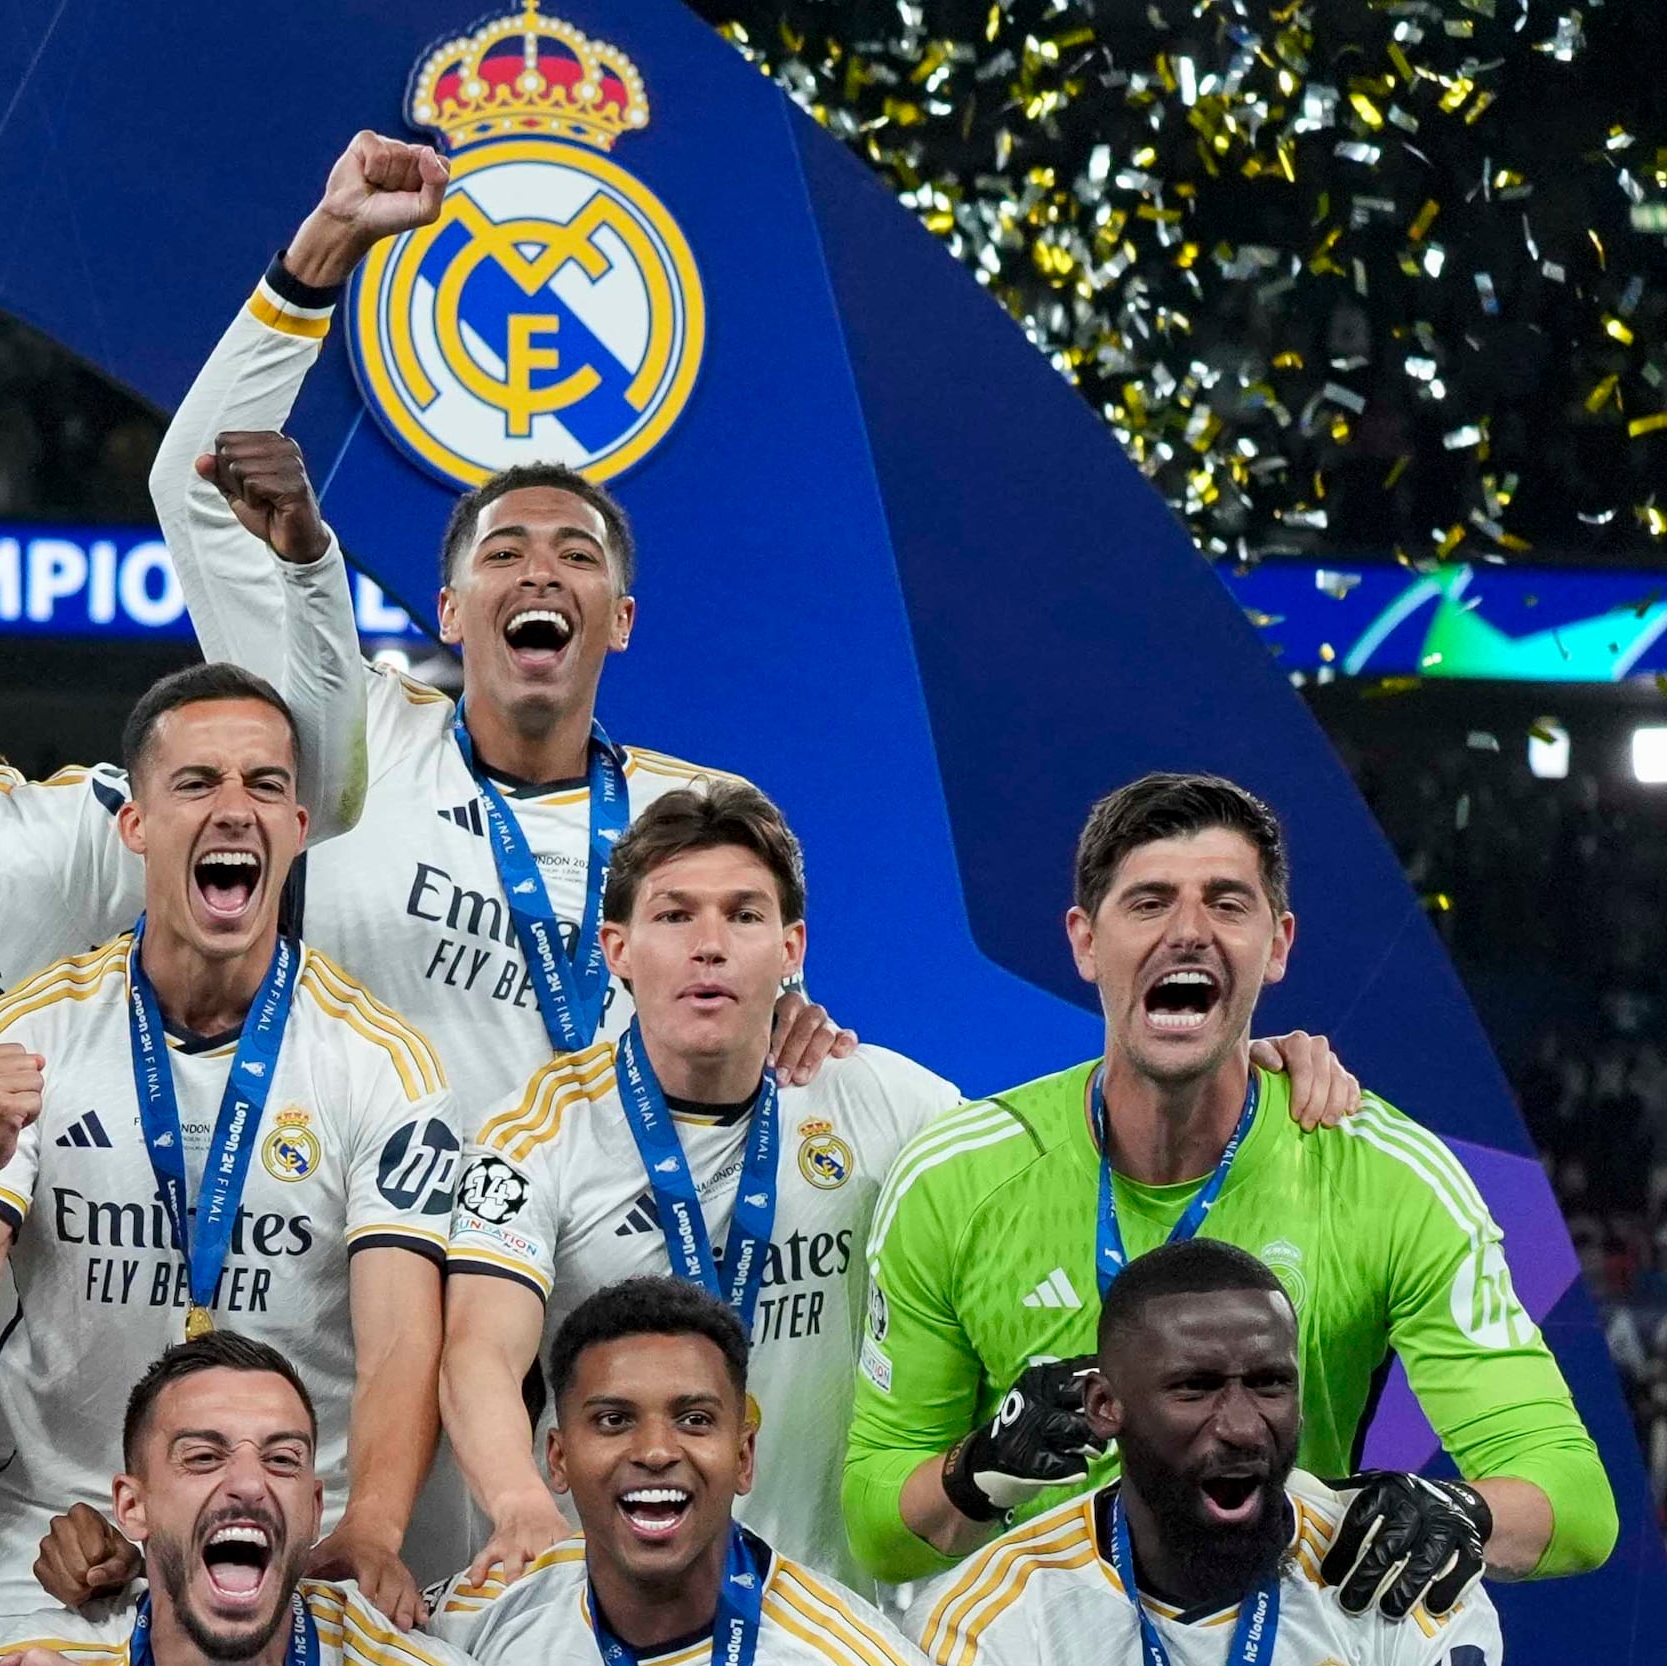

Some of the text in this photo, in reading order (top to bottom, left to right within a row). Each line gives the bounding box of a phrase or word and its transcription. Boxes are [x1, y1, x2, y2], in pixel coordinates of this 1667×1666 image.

[426, 940, 491, 990] FLY
[547, 973, 561, 992] 24
[553, 994, 575, 1040] FINAL
[181, 1124, 211, 1133] NDON
[220, 1153, 234, 1173] 24
[376, 1118, 460, 1215] hp
[209, 1178, 229, 1223] FINAL
[471, 1176, 514, 1209] 14
[52, 1186, 312, 1256] Emites
[86, 1257, 138, 1302] FLY
[759, 1292, 823, 1346] TTER
[1244, 1642, 1257, 1662] 24
